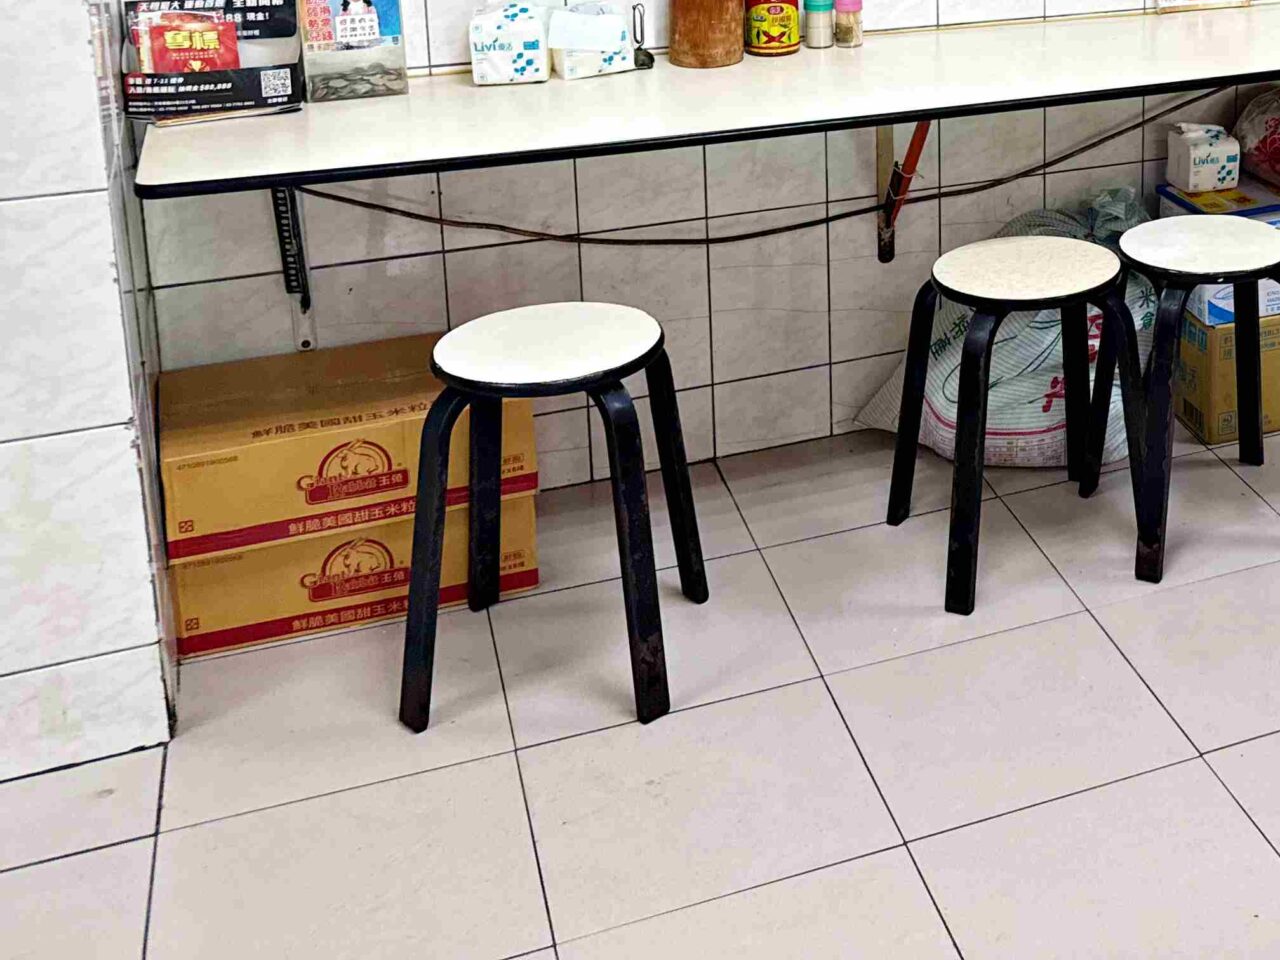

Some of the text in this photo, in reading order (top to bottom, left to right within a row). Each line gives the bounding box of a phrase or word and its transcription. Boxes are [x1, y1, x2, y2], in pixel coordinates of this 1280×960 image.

[473, 37, 498, 52] Livi
[1193, 153, 1212, 166] Livi
[288, 500, 417, 536] 鮮脆美國甜玉米粒
